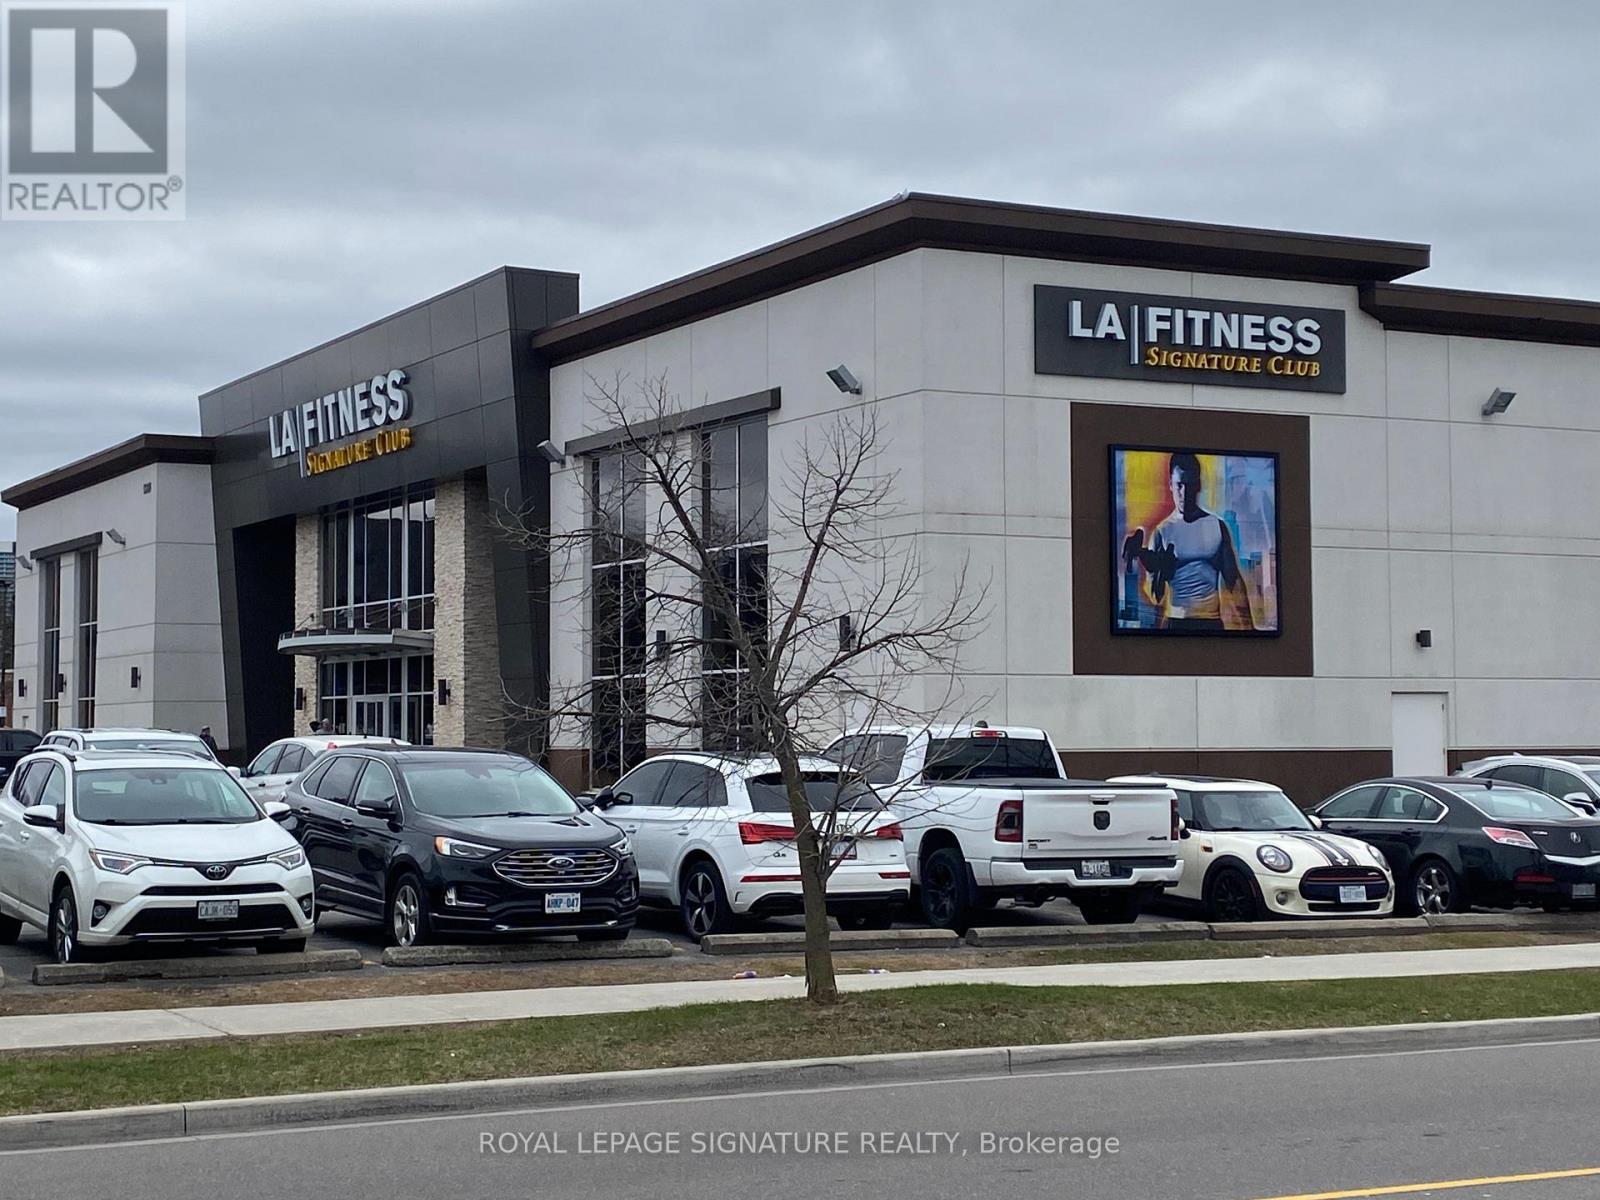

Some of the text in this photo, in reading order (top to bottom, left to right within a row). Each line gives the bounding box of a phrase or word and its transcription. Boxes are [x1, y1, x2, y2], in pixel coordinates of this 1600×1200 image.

[1068, 300, 1322, 356] LA FITNESS
[1146, 346, 1321, 377] SIGNATURE CLUB
[269, 369, 409, 459] LA FITNESS
[306, 428, 411, 477] SIGNATURE CLUB
